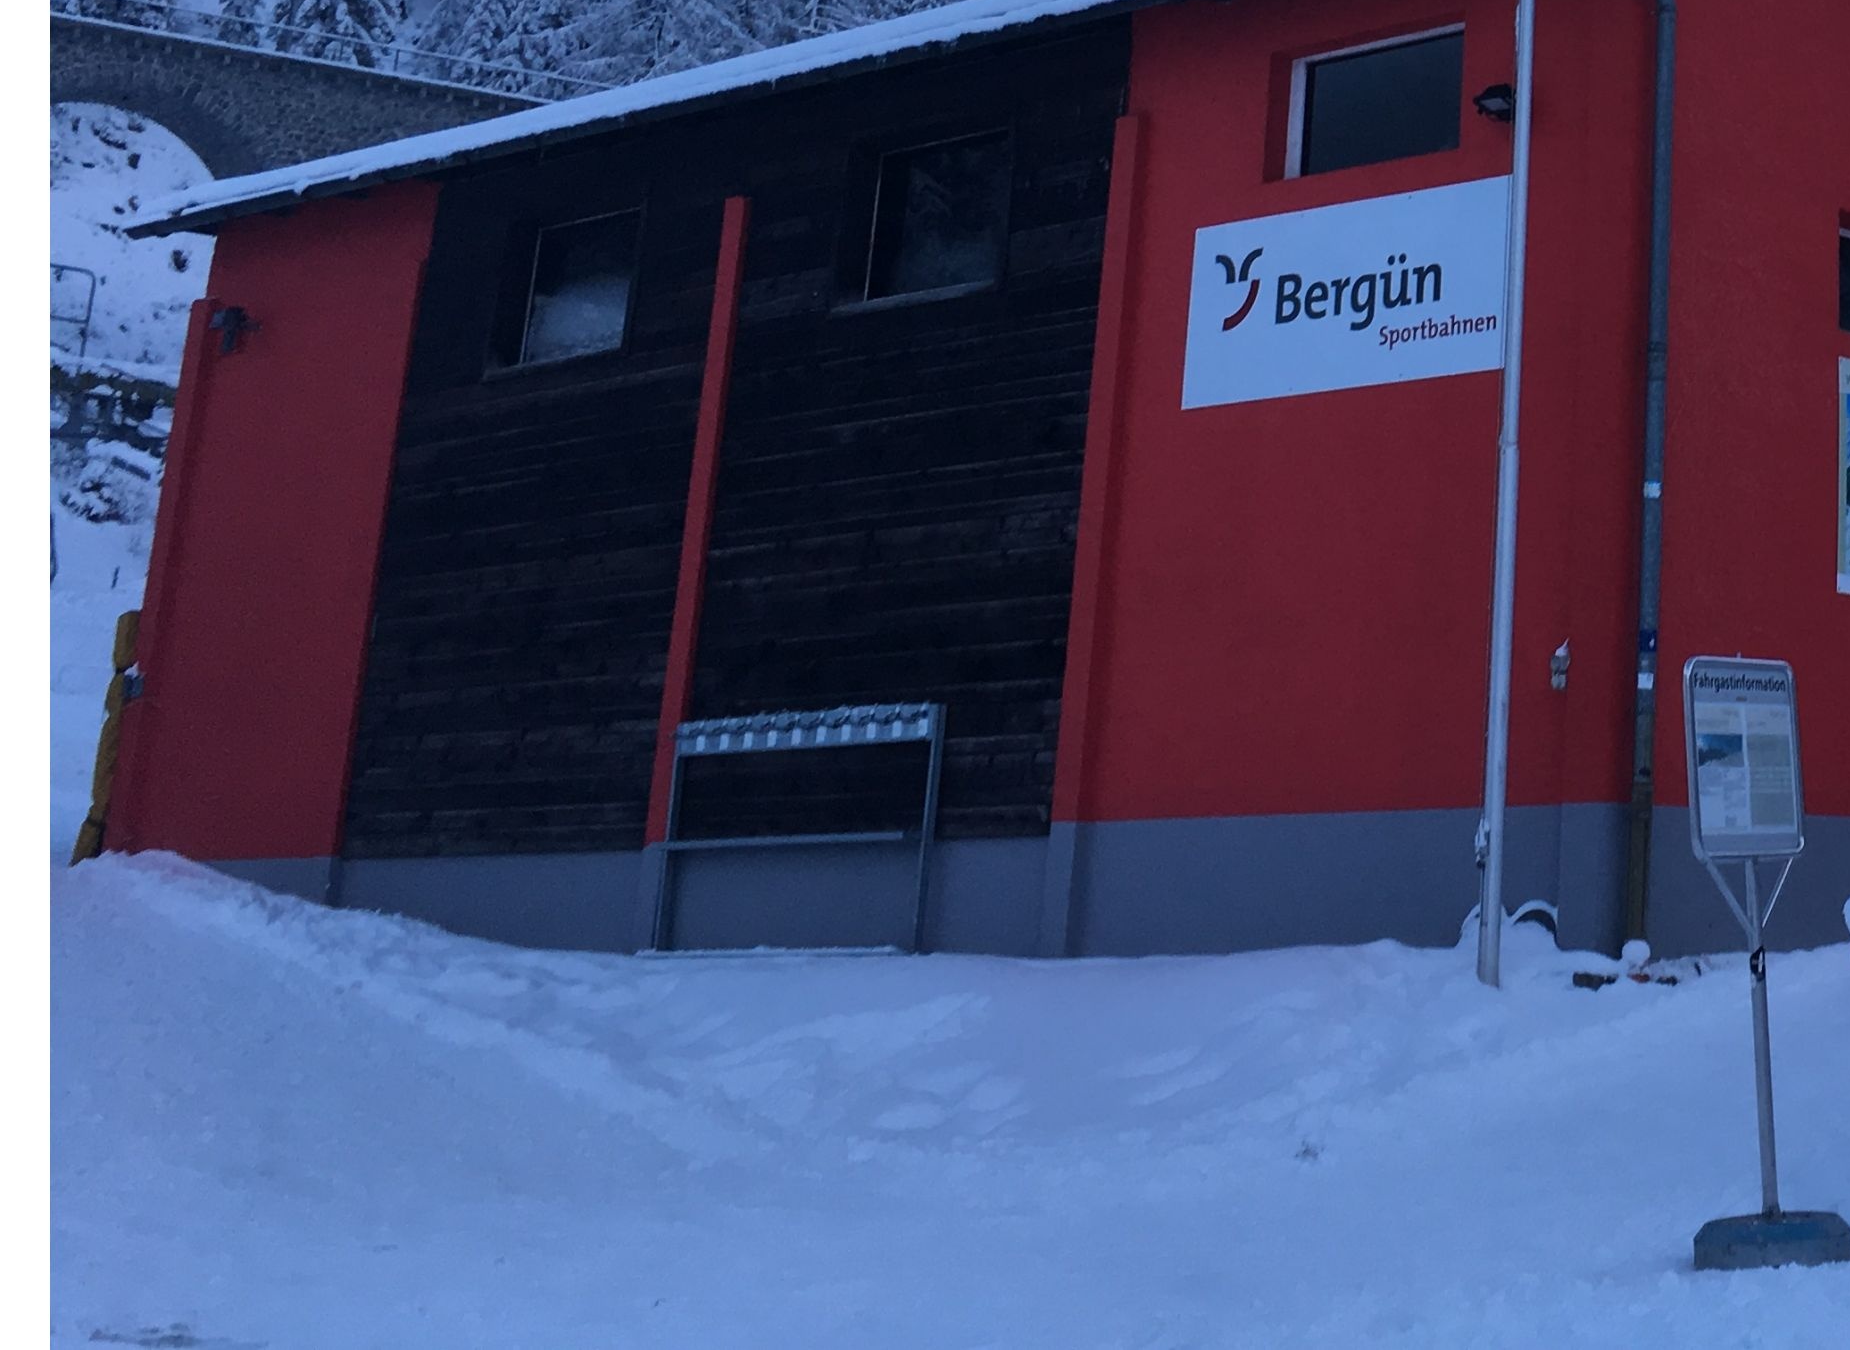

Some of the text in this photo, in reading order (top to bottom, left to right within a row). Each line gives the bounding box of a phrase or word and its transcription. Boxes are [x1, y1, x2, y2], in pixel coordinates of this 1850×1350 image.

[1275, 253, 1442, 331] Bergün
[1379, 314, 1497, 350] Sportbahnen
[1694, 672, 1787, 693] Fahrgastinformation
